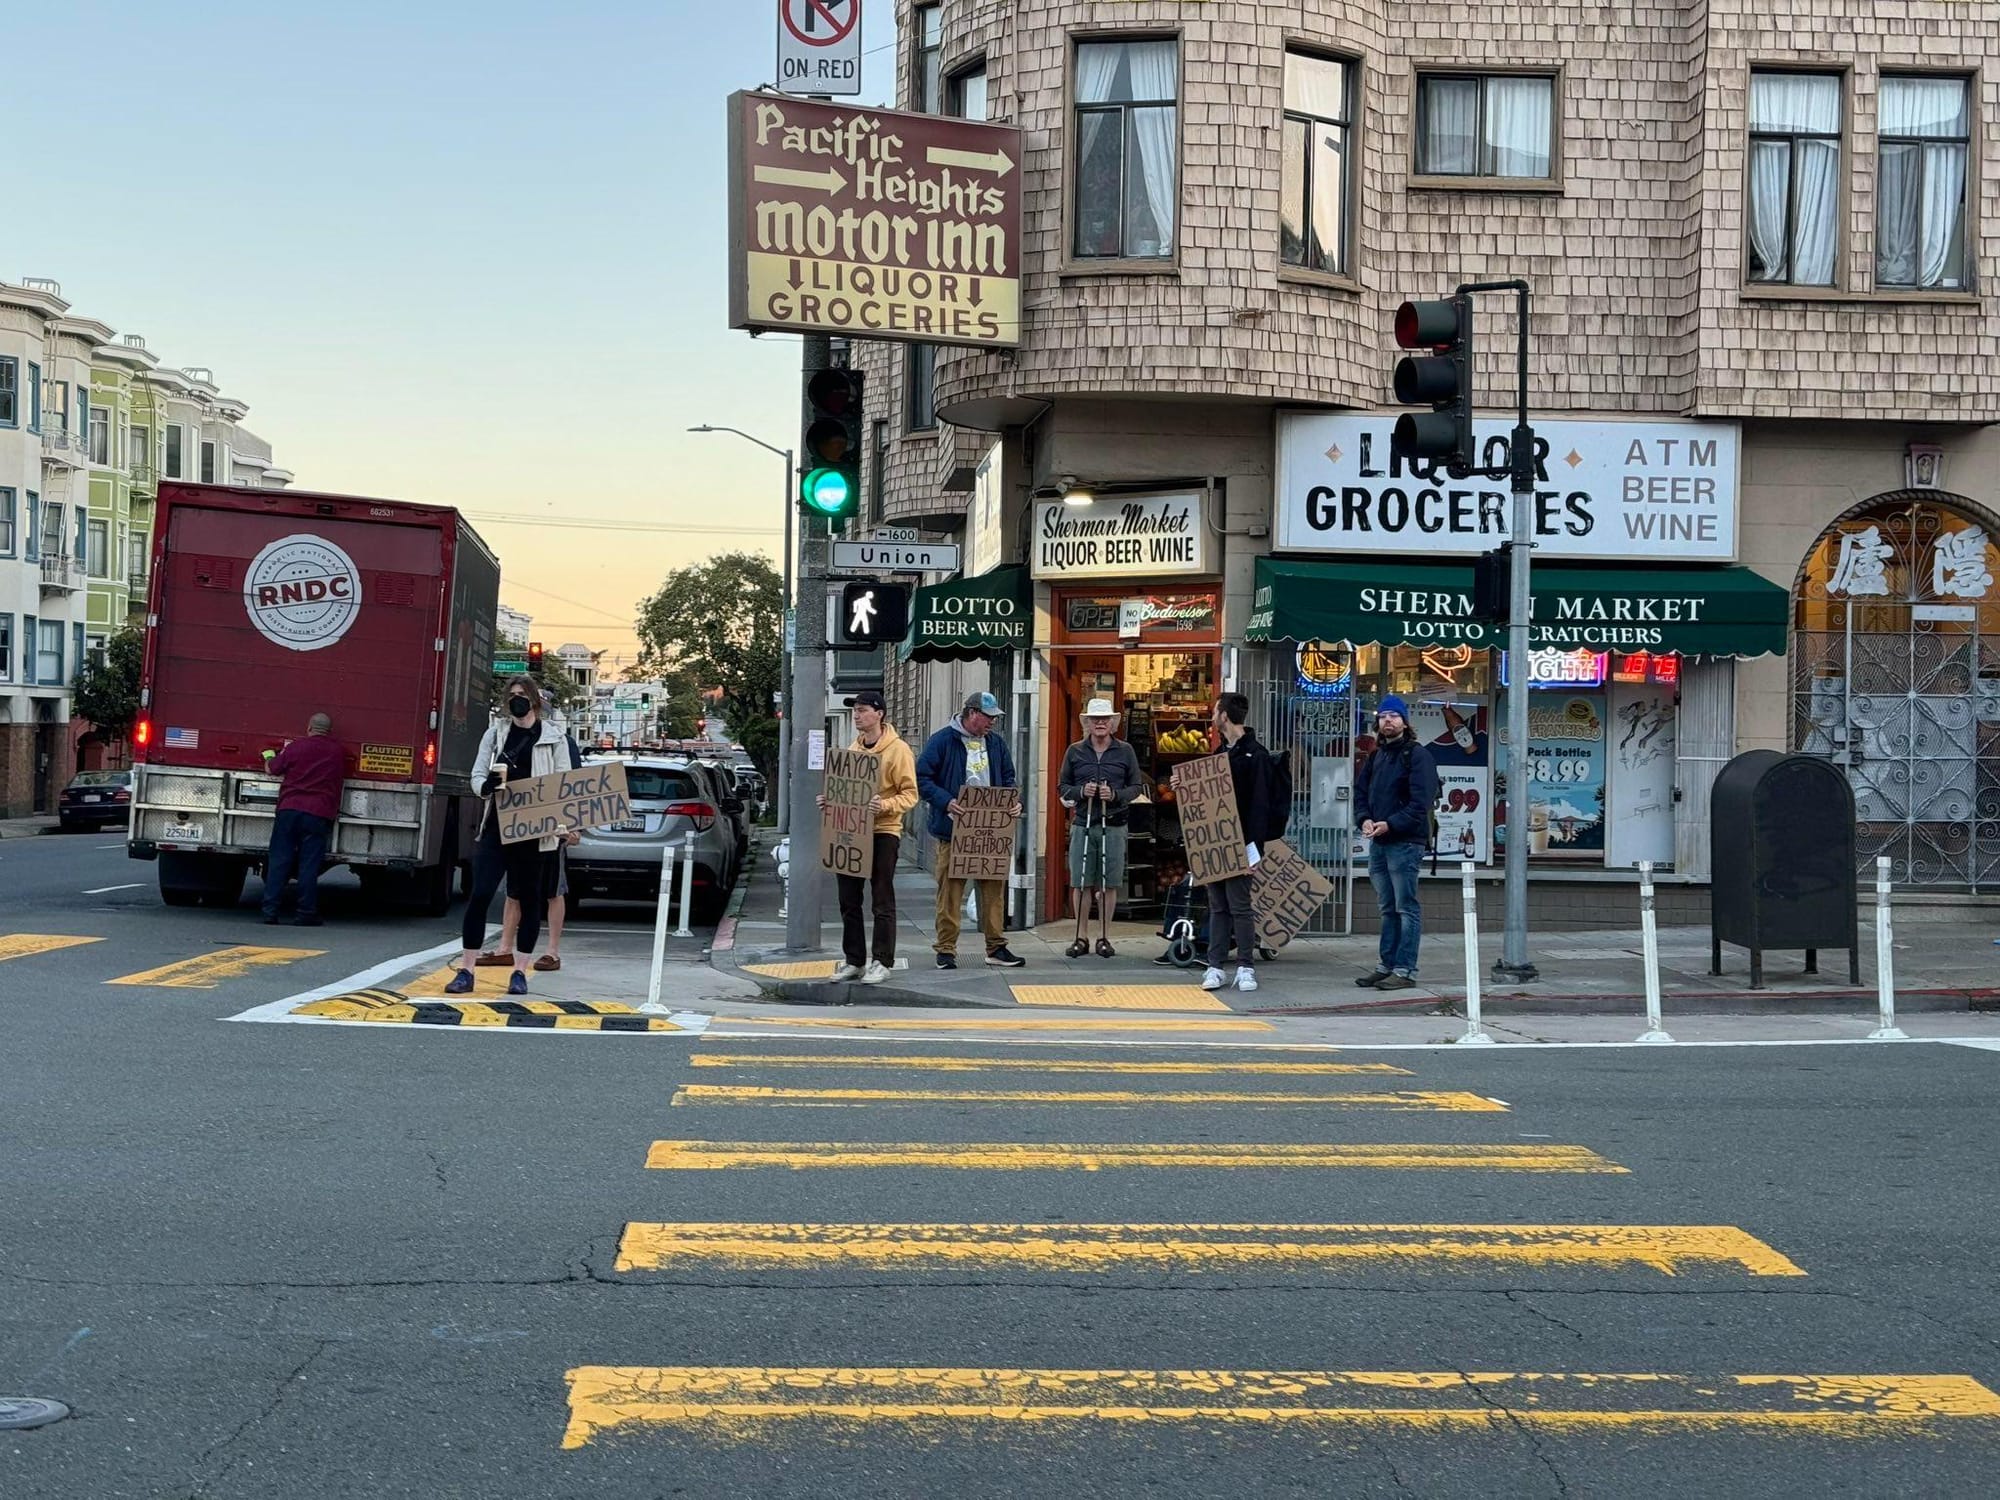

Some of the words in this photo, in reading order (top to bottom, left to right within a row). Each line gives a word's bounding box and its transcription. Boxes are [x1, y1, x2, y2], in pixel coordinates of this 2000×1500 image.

[784, 58, 808, 78] ON
[818, 59, 855, 79] RED
[755, 102, 904, 165] Pacific
[856, 157, 1006, 217] Heights
[812, 261, 958, 303] LIQUOR
[767, 291, 999, 339] GROCERIES
[1622, 476, 1717, 504] BEER
[1043, 506, 1120, 539] Sherman
[1120, 503, 1189, 537] Market
[1305, 485, 1596, 537] GROCERES
[888, 529, 915, 541] 1600
[1623, 512, 1719, 542] WINE
[860, 548, 931, 565] Union
[1042, 541, 1098, 571] LIQUOR
[1105, 539, 1142, 564] BEER
[1149, 536, 1194, 562] WINE
[258, 576, 350, 607] RNDC
[930, 597, 1015, 616] LOTTO
[1126, 609, 1138, 618] NO
[1140, 603, 1212, 620] Budweiser
[1556, 596, 1705, 622] MARKET
[1176, 620, 1193, 632] 1598
[1402, 620, 1484, 639] LOTTO
[1529, 625, 1663, 645] CRATCHERS
[365, 745, 410, 756] CAUTION
[1555, 747, 1592, 757] Bottles
[826, 750, 880, 783] MAYOR
[1174, 755, 1227, 783] TRAFFIC
[499, 777, 545, 811] Don't
[558, 765, 612, 800] back
[826, 776, 873, 807] BREED
[960, 791, 974, 808] A
[973, 787, 1019, 809] DRIVER
[1179, 773, 1233, 805] DEATHS
[503, 813, 558, 839] down
[562, 793, 632, 830] SFMTA
[823, 804, 869, 836] FINISH
[957, 811, 1013, 829] KILLED
[1183, 802, 1207, 825] ARE
[1216, 798, 1231, 817] A
[953, 836, 1013, 857] NEIGHBOR
[974, 829, 994, 838] OUR
[1185, 815, 1240, 849] POLICY
[822, 842, 863, 874] JOB
[953, 856, 1008, 876] HERE
[1189, 842, 1248, 881] CHOICE
[1269, 853, 1306, 897] STREETS
[1263, 879, 1326, 948] SAFER
